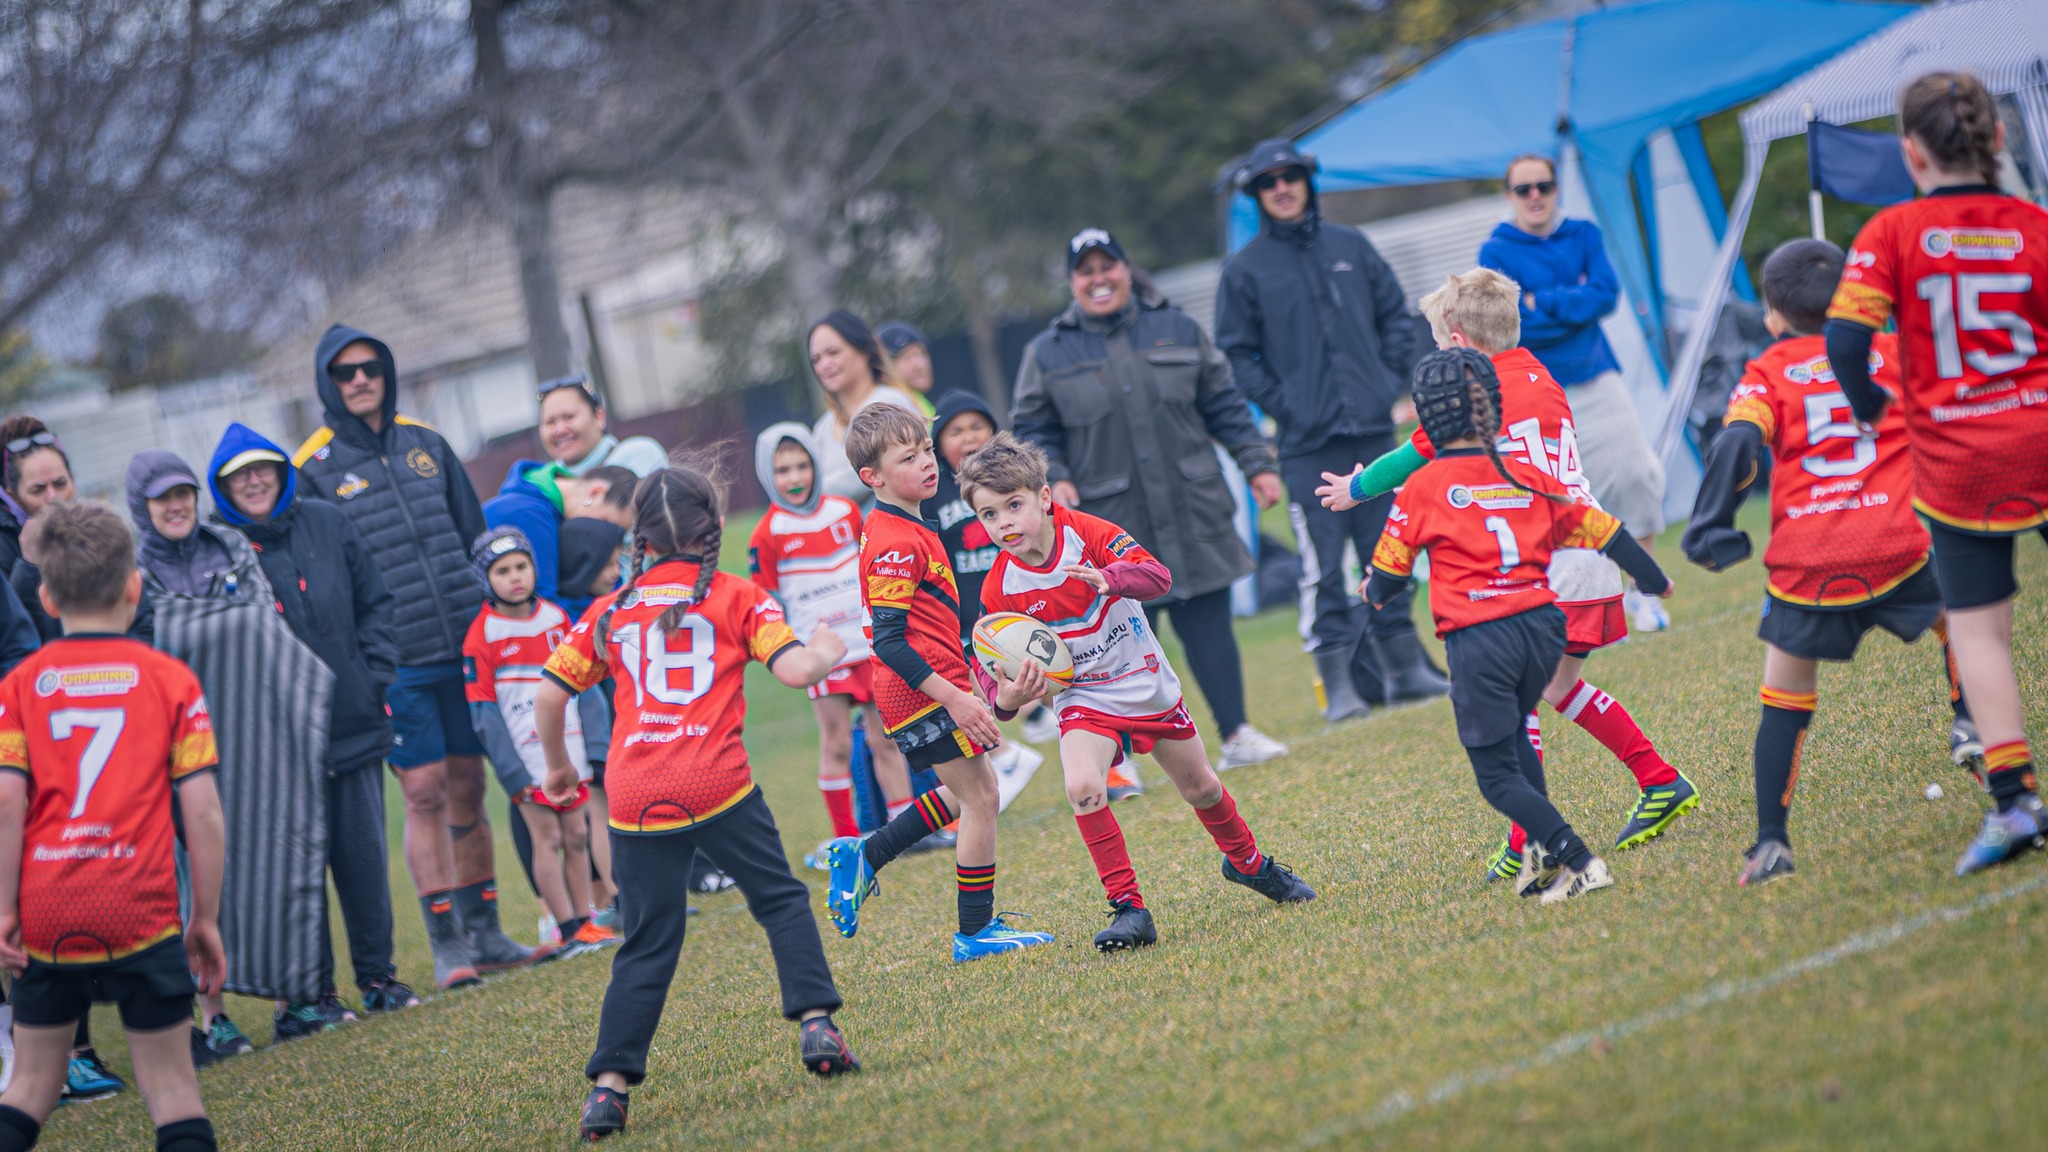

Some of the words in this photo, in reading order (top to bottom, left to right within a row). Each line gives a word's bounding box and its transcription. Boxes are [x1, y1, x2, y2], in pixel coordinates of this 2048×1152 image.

[1917, 273, 2038, 379] 15
[1508, 417, 1590, 490] 14
[1801, 392, 1878, 478] 5
[876, 567, 897, 576] Miles
[898, 568, 911, 578] Kia
[1486, 516, 1520, 575] 1
[643, 587, 694, 599] CHIPMUN
[611, 612, 716, 708] 18
[1072, 644, 1105, 661] WAKA
[638, 711, 684, 726] FENWIC
[686, 724, 708, 737] LTD
[50, 708, 126, 819] 7
